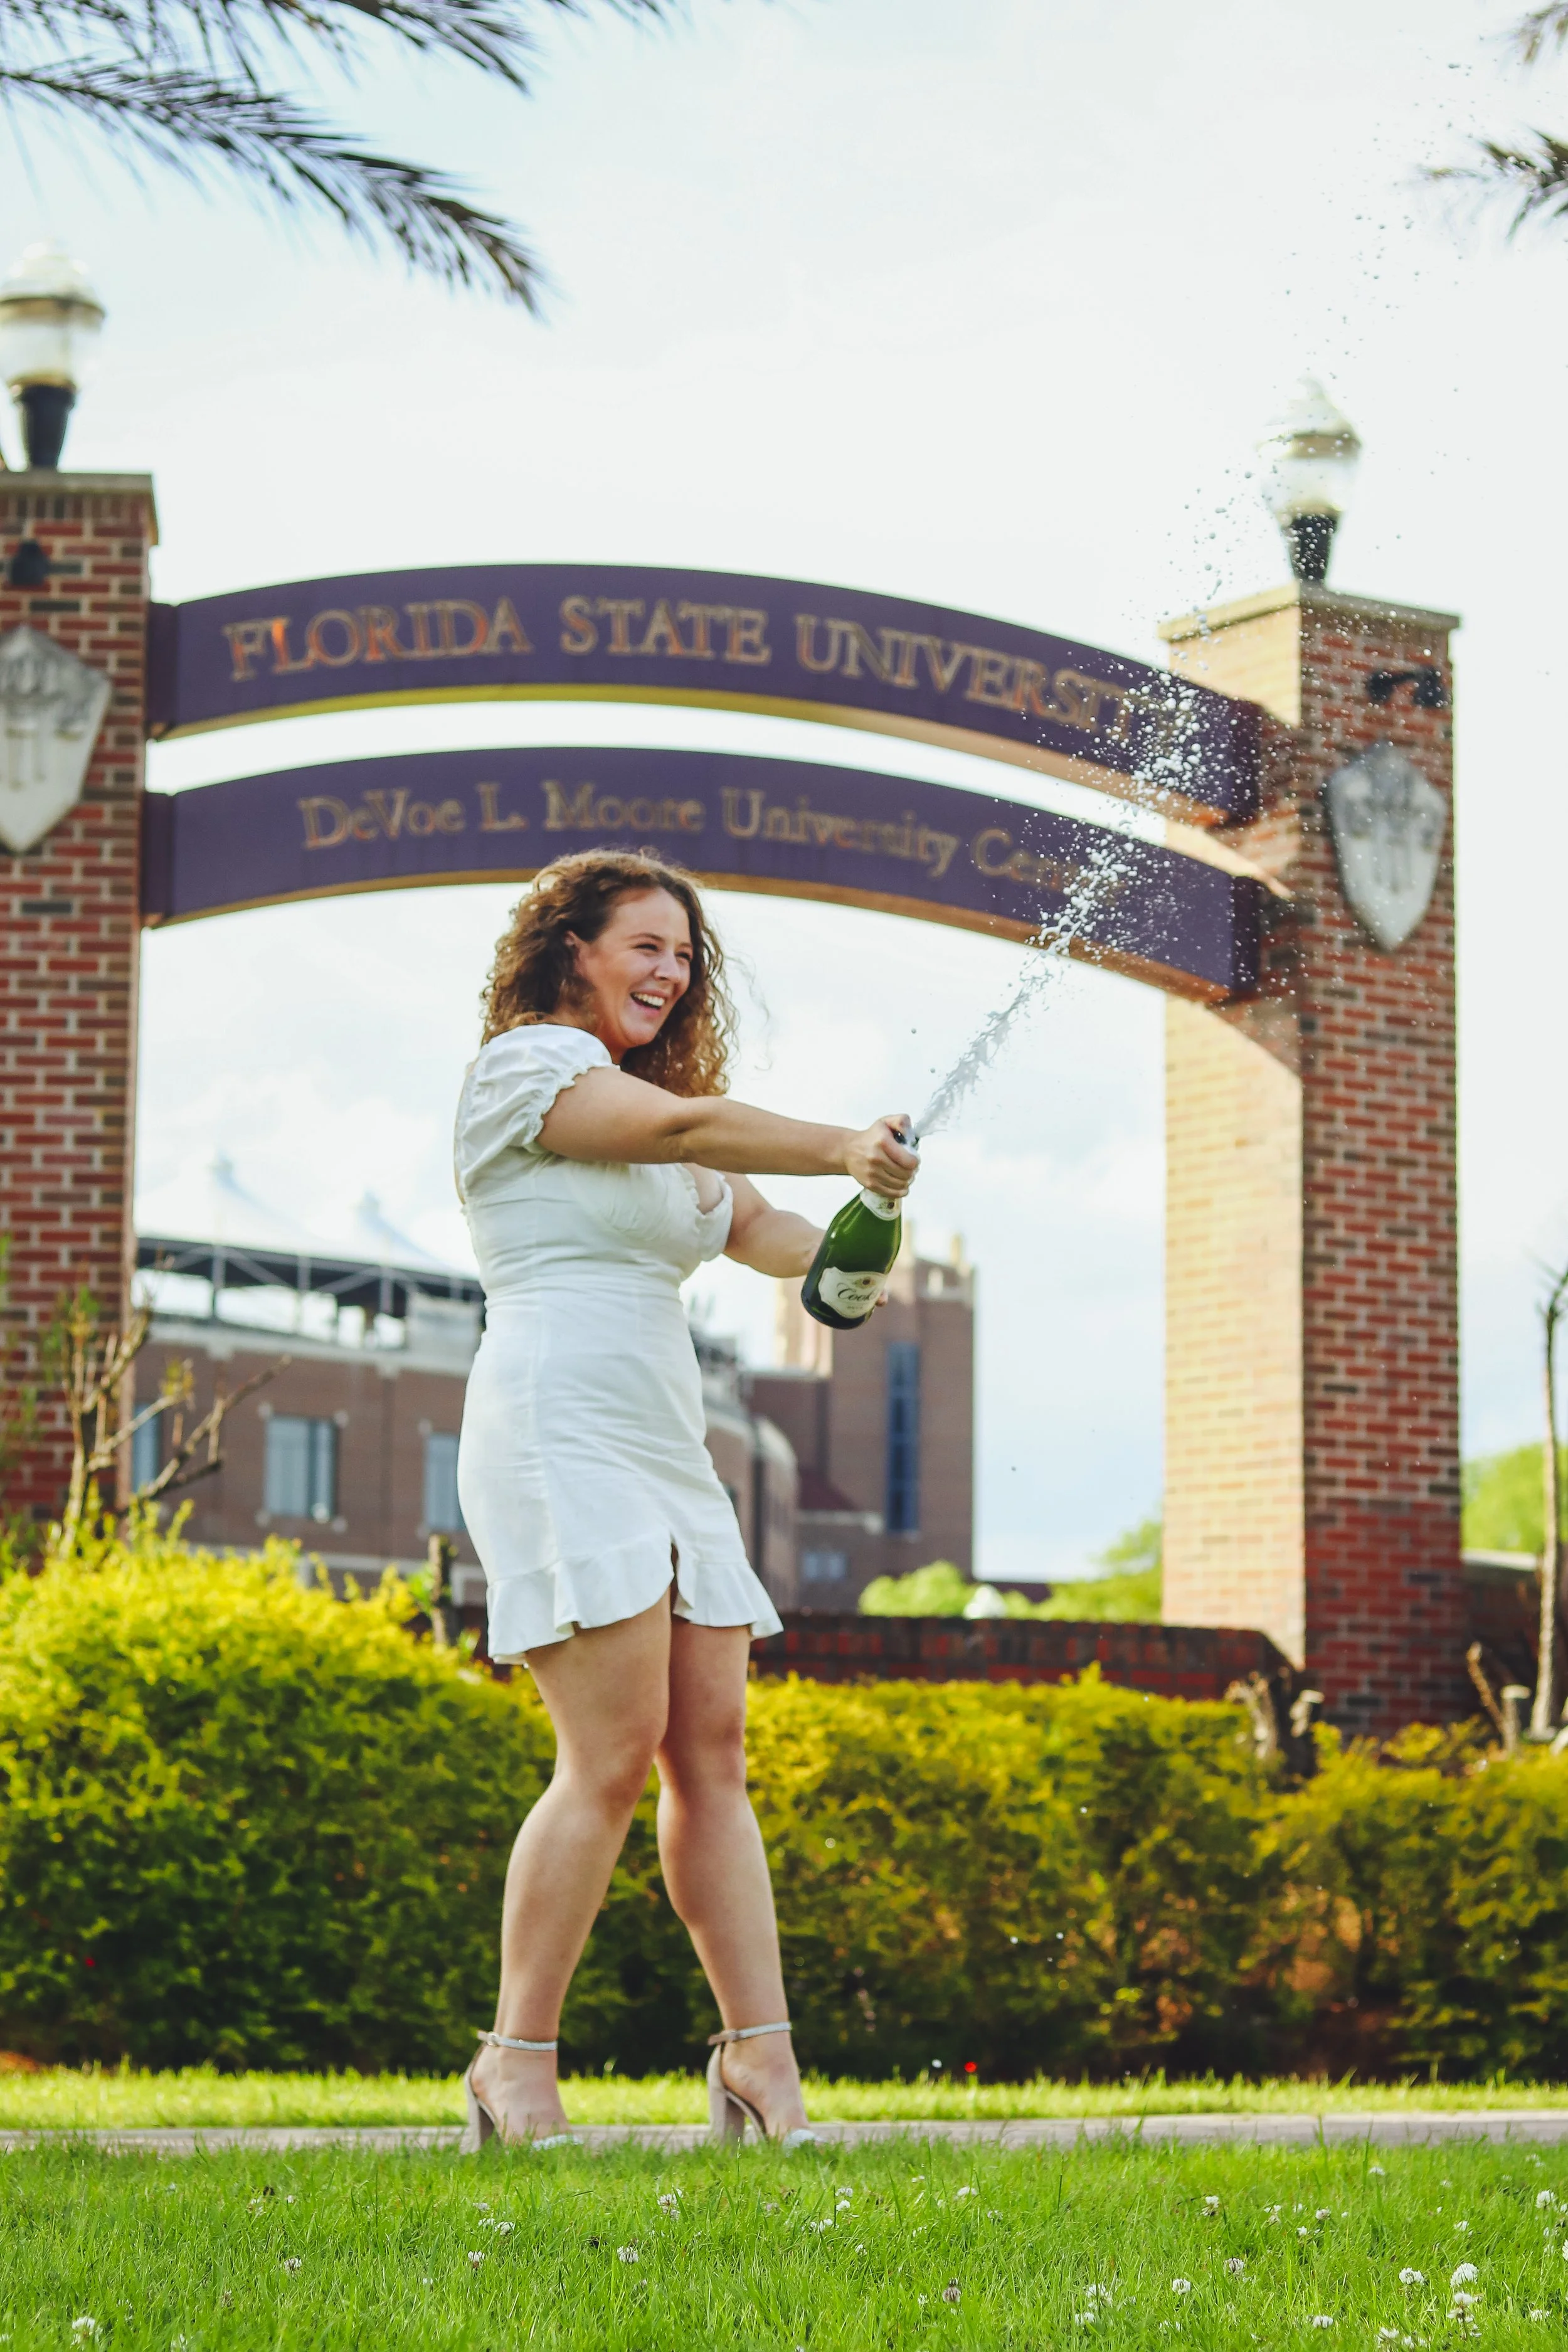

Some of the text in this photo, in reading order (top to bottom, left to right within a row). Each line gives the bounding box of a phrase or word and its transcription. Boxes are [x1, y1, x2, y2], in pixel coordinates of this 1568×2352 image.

[223, 597, 534, 681] FLORIDA
[559, 595, 773, 664] STATE
[297, 788, 466, 850] DeVoe
[541, 779, 706, 833] Moore
[719, 785, 960, 877] University
[971, 827, 1130, 907] Cen
